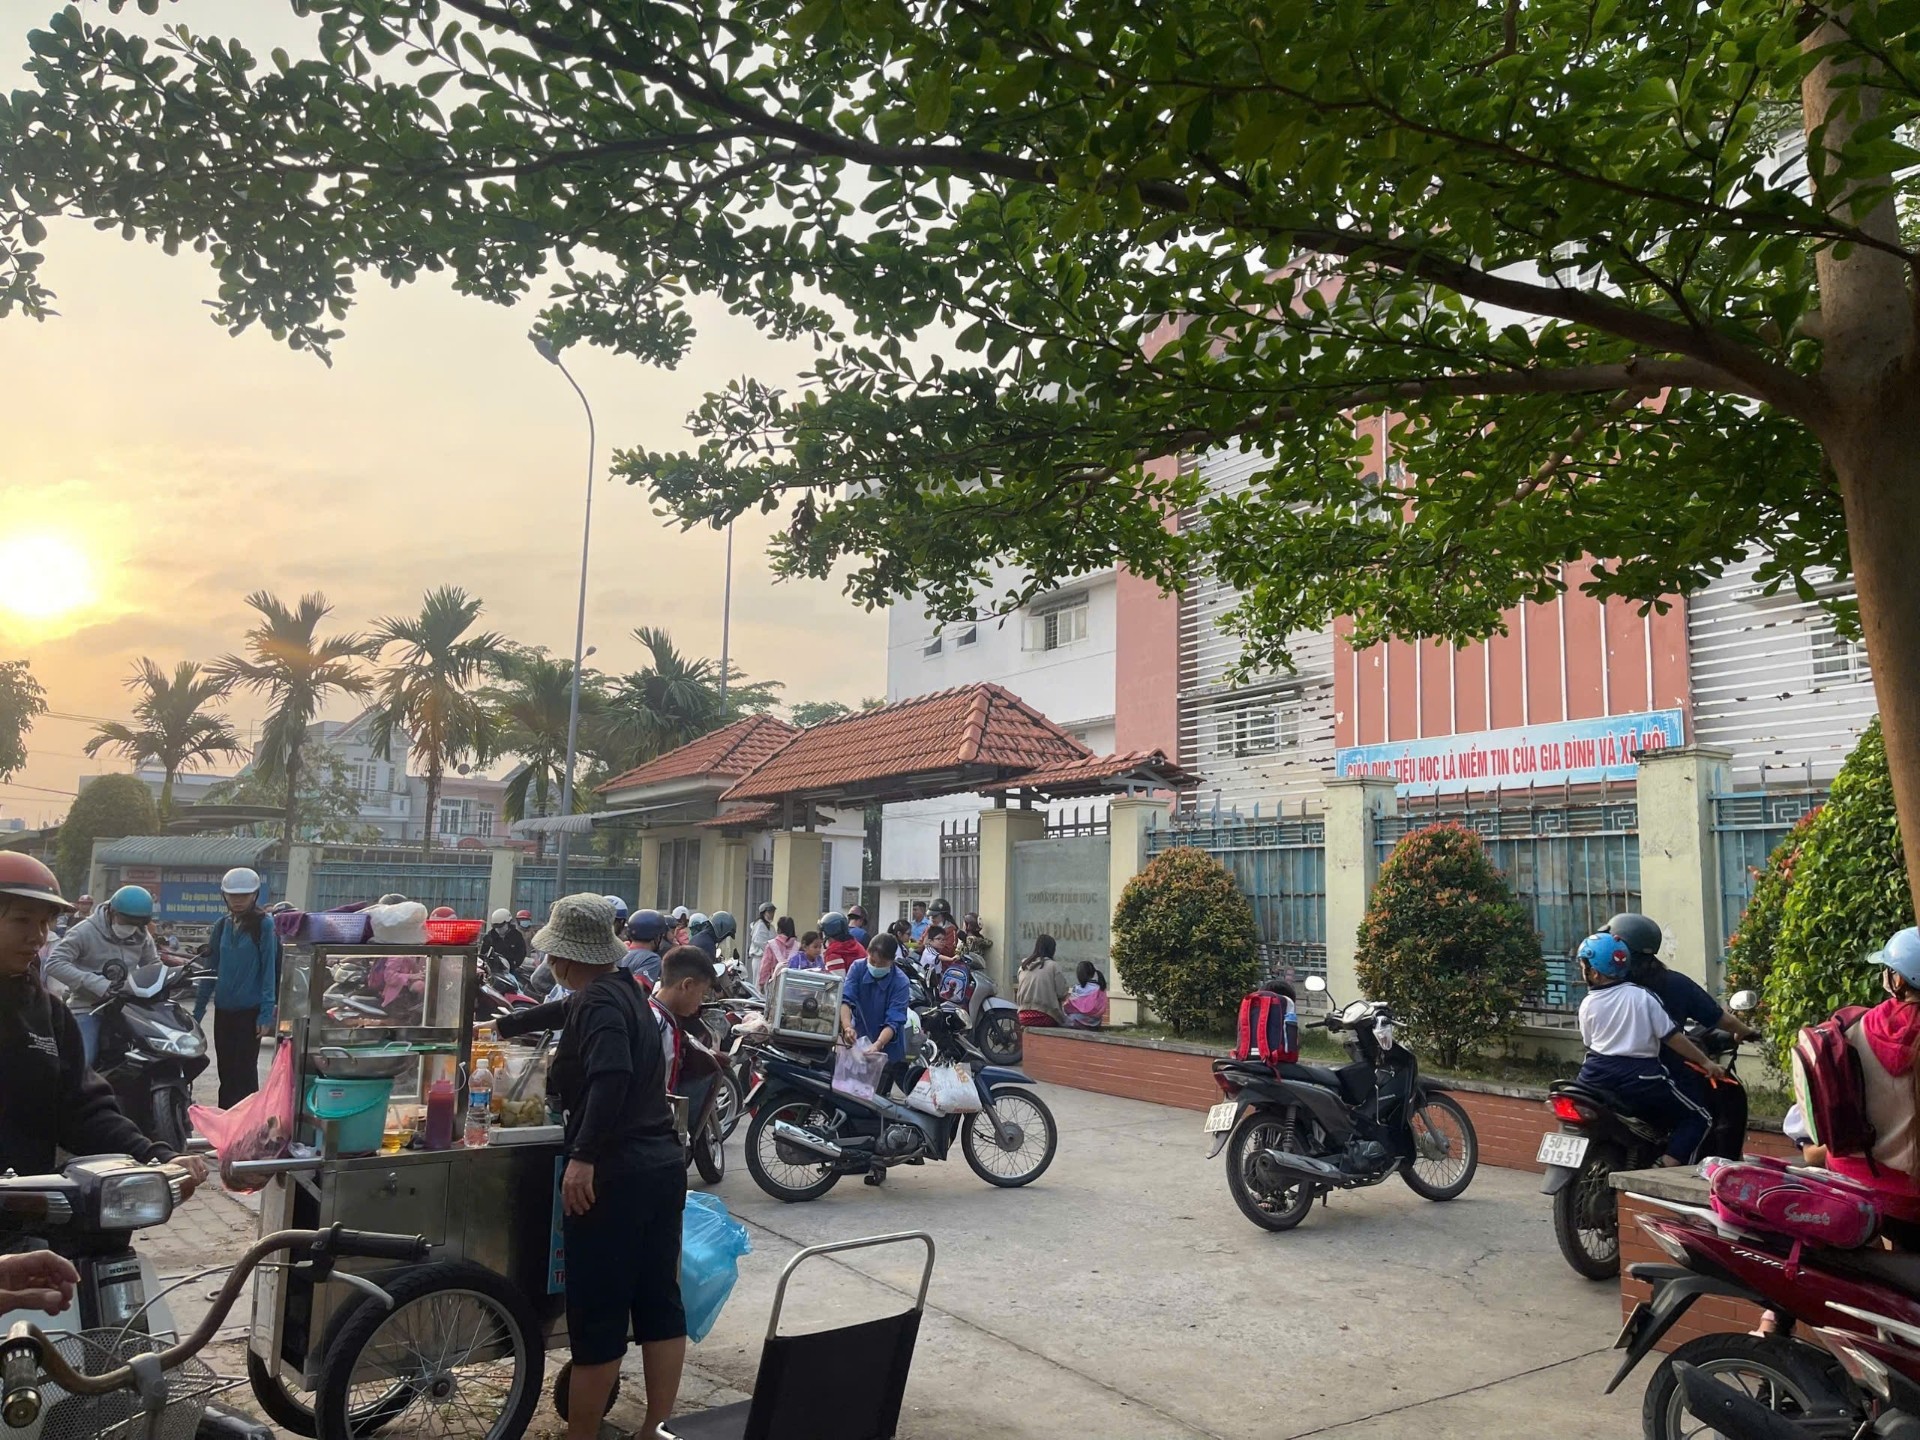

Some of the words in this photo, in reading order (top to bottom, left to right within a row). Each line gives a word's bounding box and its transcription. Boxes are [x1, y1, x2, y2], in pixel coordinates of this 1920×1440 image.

[1419, 755, 1440, 787] HỌC
[1443, 750, 1457, 781] LÀ
[1459, 743, 1488, 779] NIỀM
[1491, 749, 1510, 776] TIN
[1513, 737, 1537, 774] CỦA
[1540, 743, 1562, 772] GIA
[1564, 735, 1596, 770] ĐÌNH
[1599, 731, 1617, 766] VÀ
[1620, 729, 1638, 764] XÃ
[1542, 1149, 1581, 1166] 919.51
